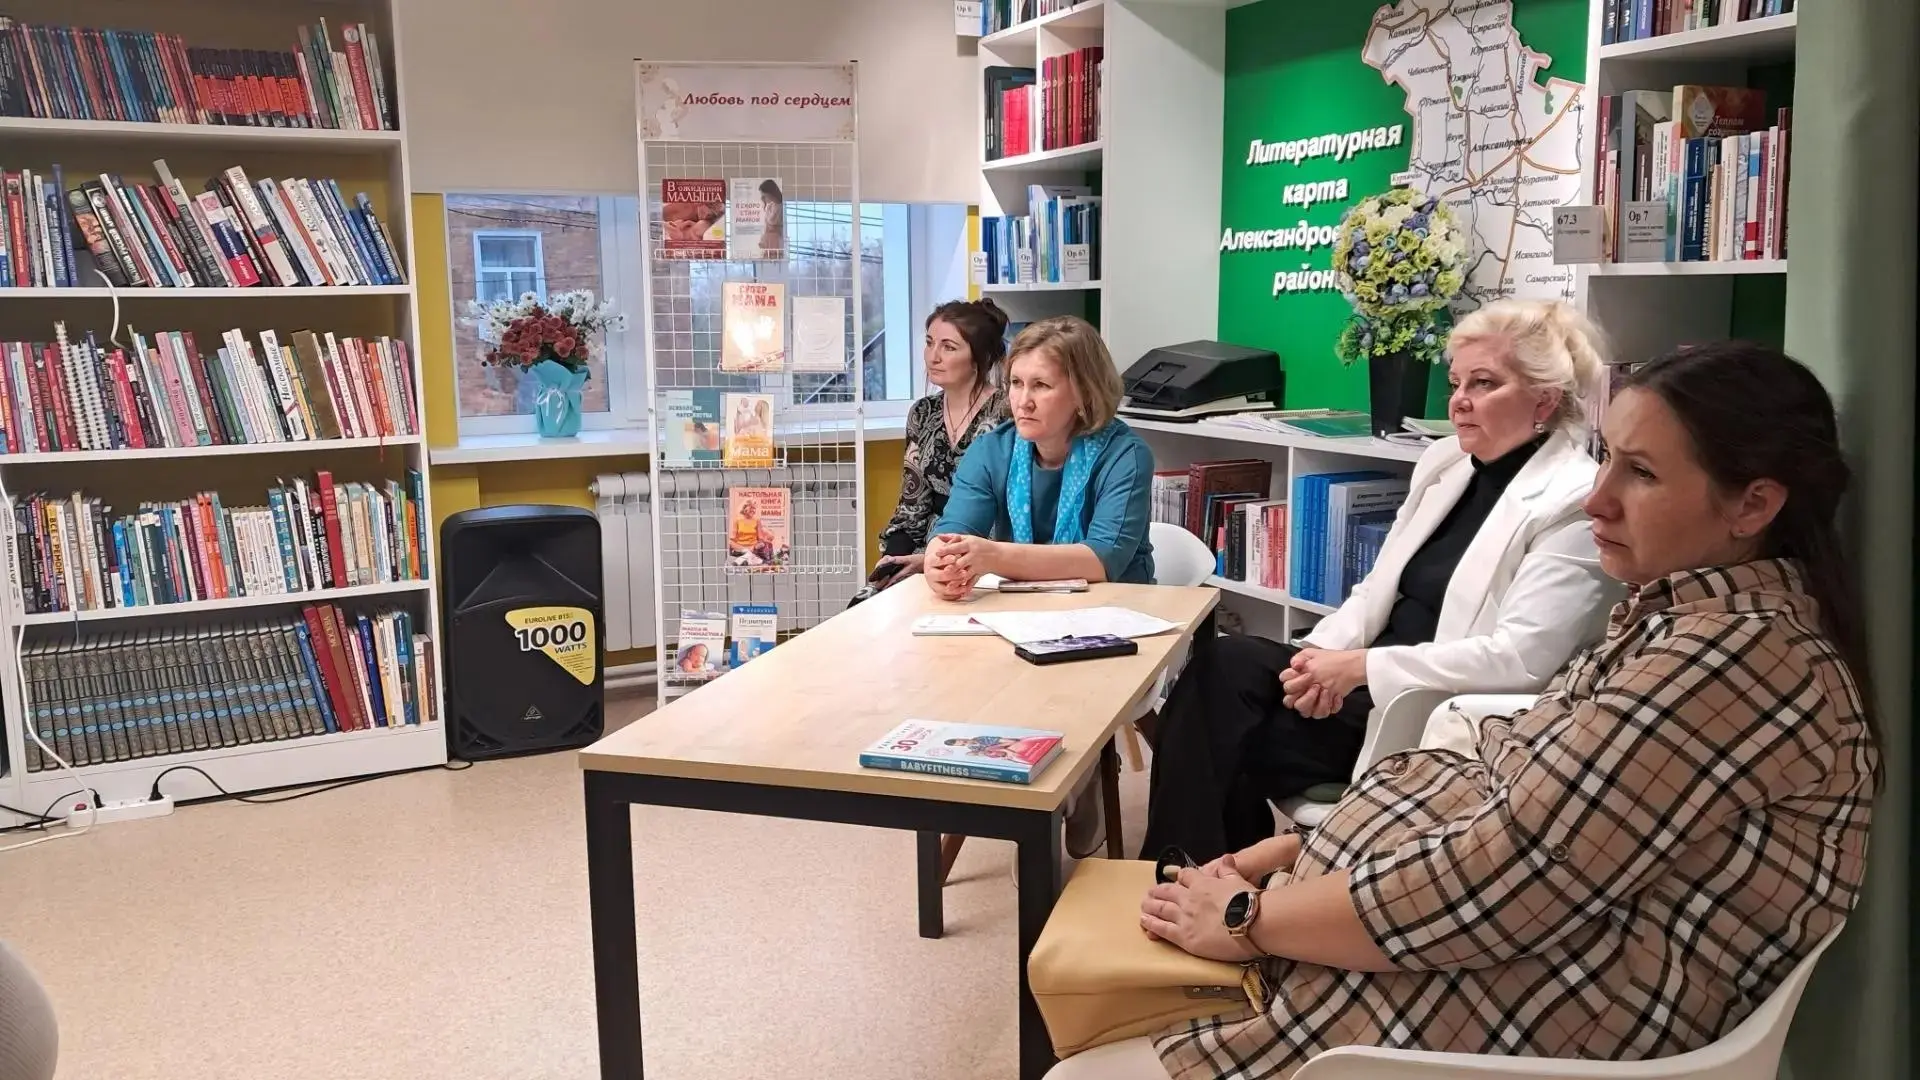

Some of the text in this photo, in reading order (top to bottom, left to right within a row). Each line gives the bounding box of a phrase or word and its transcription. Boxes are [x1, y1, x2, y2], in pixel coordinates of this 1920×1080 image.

[683, 92, 852, 108] Любовь под сердцем
[1246, 124, 1402, 166] Литературная
[667, 191, 722, 202] МАЛЫША
[1283, 178, 1348, 208] карта
[1557, 214, 1578, 225] 67.3
[1644, 210, 1649, 220] 7
[1273, 263, 1341, 296] район
[524, 614, 558, 624] EUROLIVE
[516, 622, 586, 649] 1000
[554, 642, 588, 654] WATTS
[900, 761, 970, 777] BABYFITNESS
